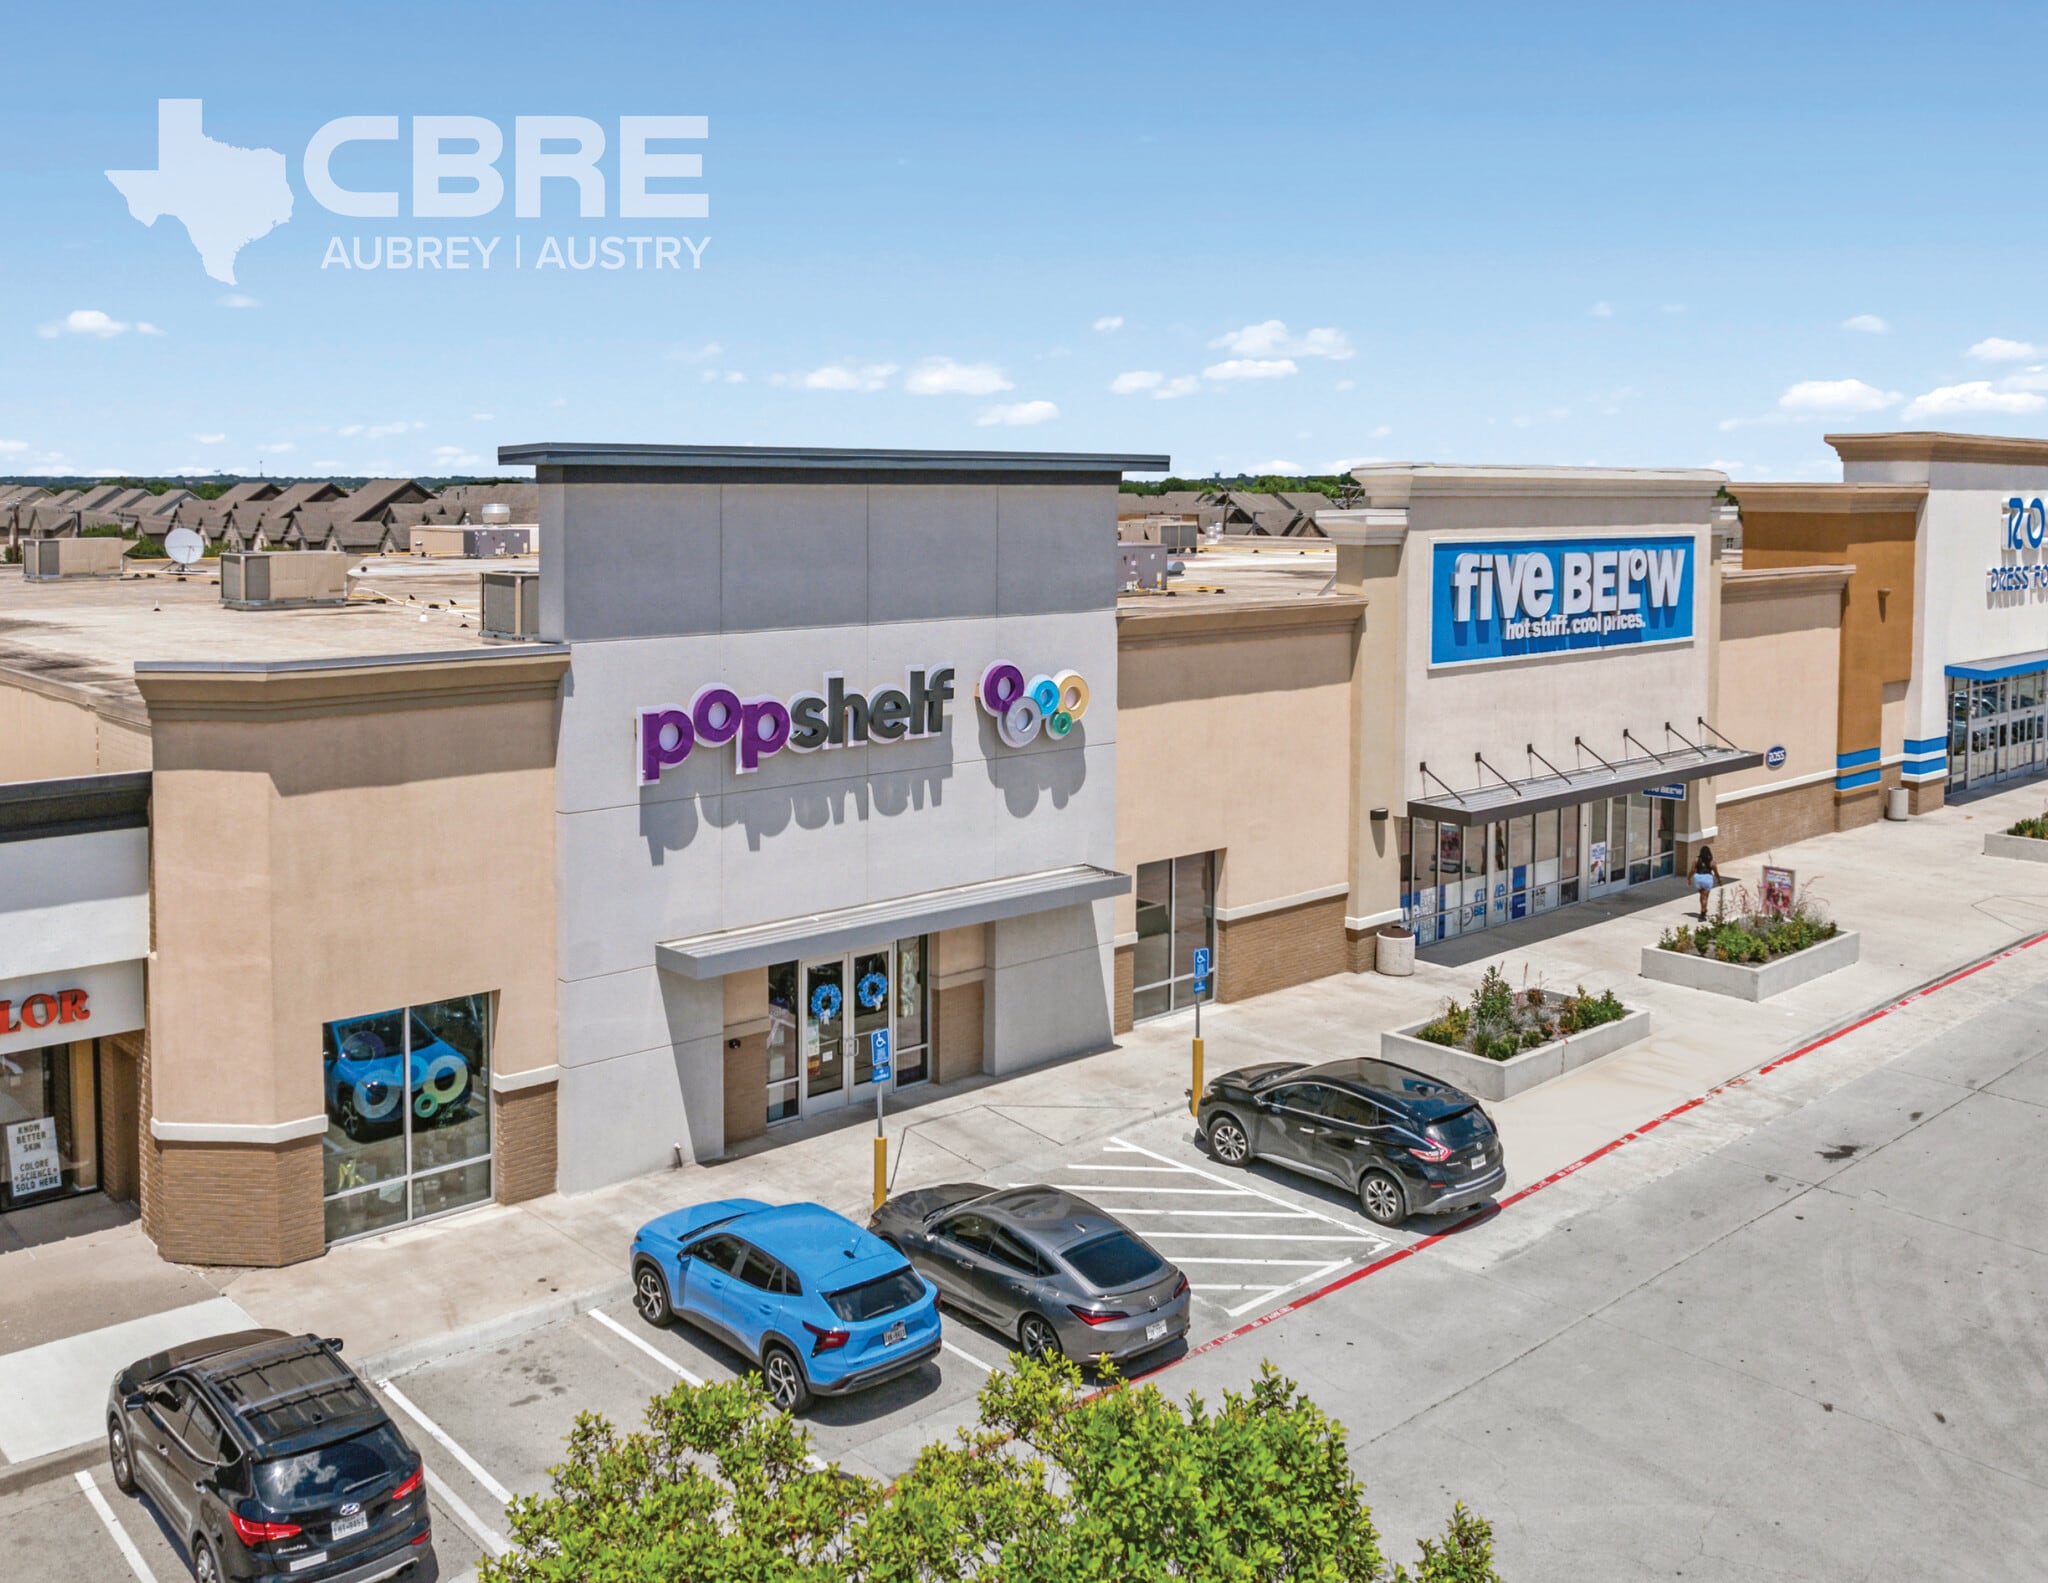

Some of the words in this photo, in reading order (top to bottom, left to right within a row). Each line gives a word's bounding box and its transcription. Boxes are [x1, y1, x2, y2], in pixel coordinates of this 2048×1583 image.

[1453, 552, 1554, 622] five
[1561, 549, 1686, 614] BELOW
[1988, 566, 2030, 592] DRESS
[1505, 619, 1531, 640] hot
[1531, 614, 1570, 636] stuff.
[1571, 612, 1602, 634] cool
[1603, 610, 1646, 635] prices.
[638, 666, 955, 785] popshelf
[0, 988, 91, 1036] LOR
[18, 1124, 41, 1134] KNOW
[16, 1131, 46, 1144] BETTER
[23, 1142, 41, 1152] SKIN
[20, 1159, 48, 1171] COLORE
[20, 1168, 52, 1182] SCIENCE
[16, 1181, 36, 1192] SOLD
[39, 1176, 58, 1186] HERE
